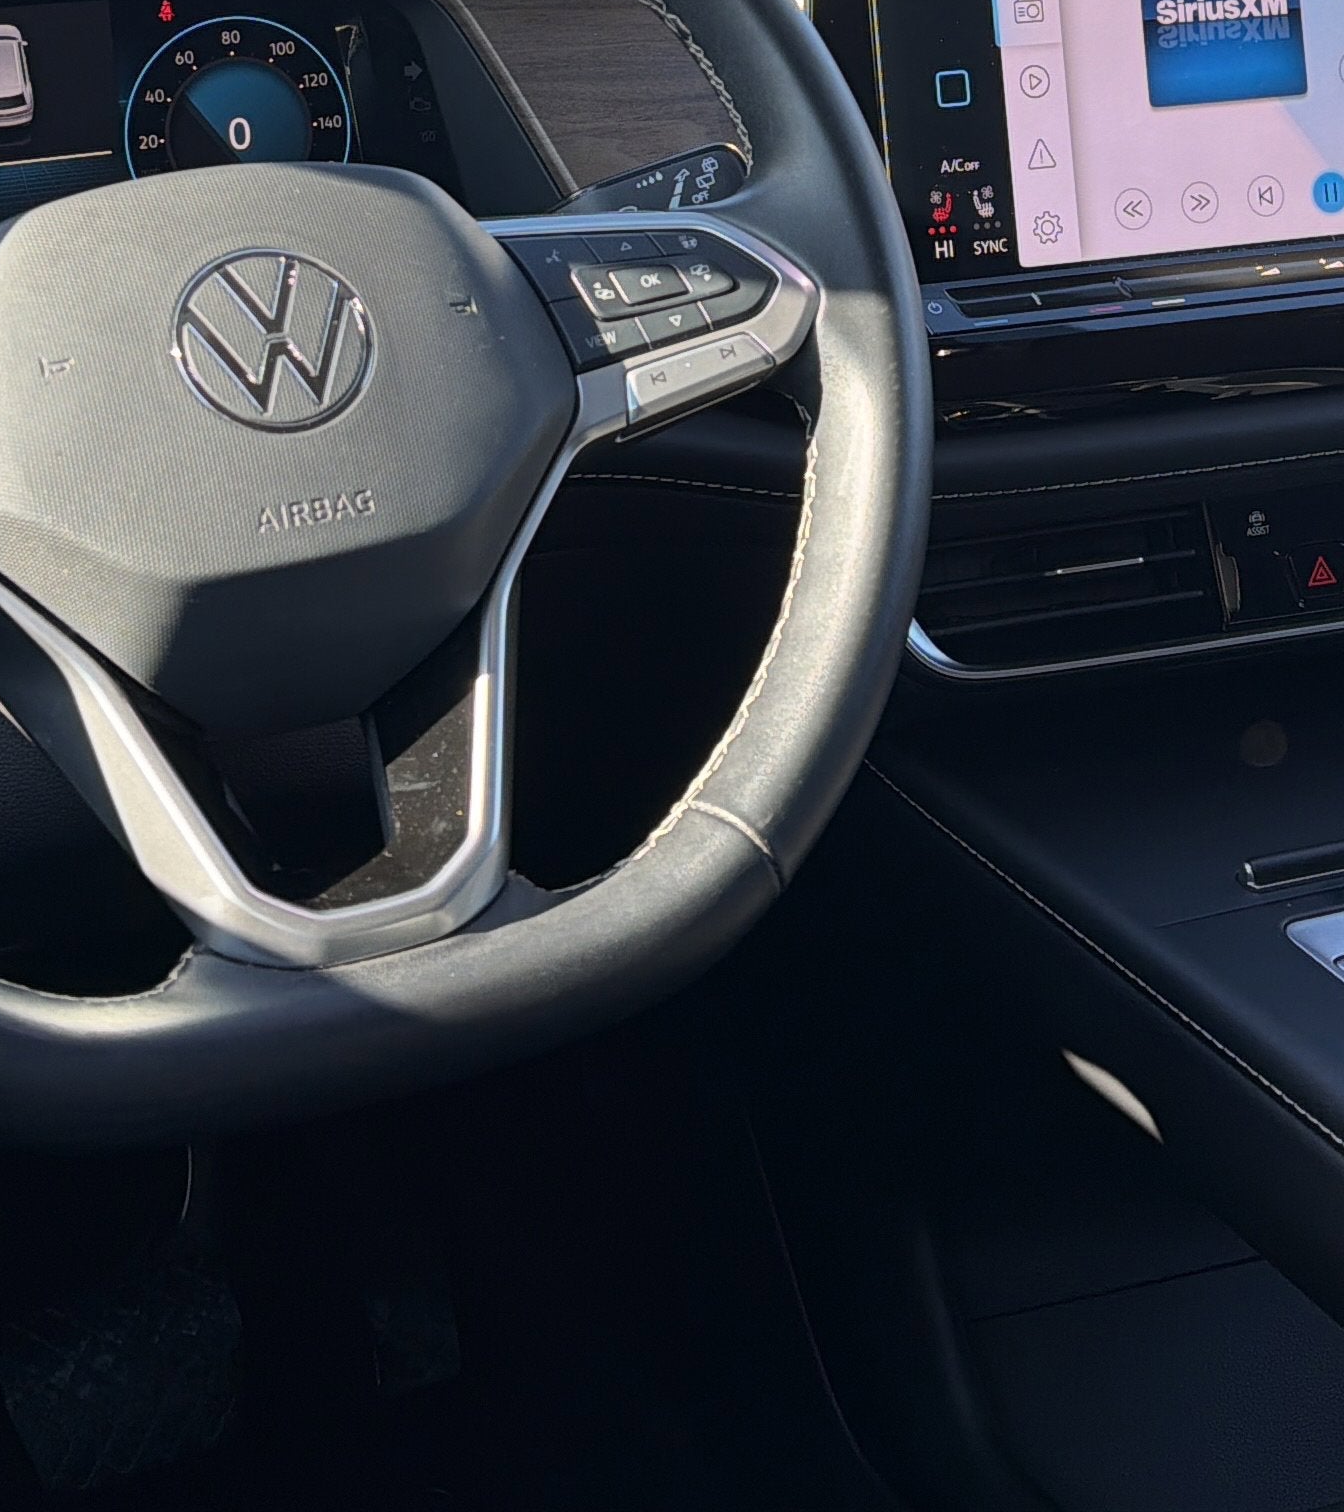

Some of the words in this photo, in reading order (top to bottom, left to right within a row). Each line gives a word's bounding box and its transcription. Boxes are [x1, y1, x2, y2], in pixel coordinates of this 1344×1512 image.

[221, 30, 240, 45] 80
[269, 41, 296, 55] 100
[175, 50, 194, 65] 60
[303, 72, 328, 87] 120
[144, 89, 165, 104] 40
[318, 115, 342, 130] 140
[228, 116, 252, 150] 0
[138, 135, 158, 150] 20
[692, 190, 711, 204] OFF
[935, 239, 955, 259] HI
[973, 237, 1009, 257] SYNC
[640, 272, 660, 288] OK
[585, 329, 617, 348] VIEW
[258, 489, 376, 534] AIRBAG
[1247, 525, 1270, 537] ASSIST
